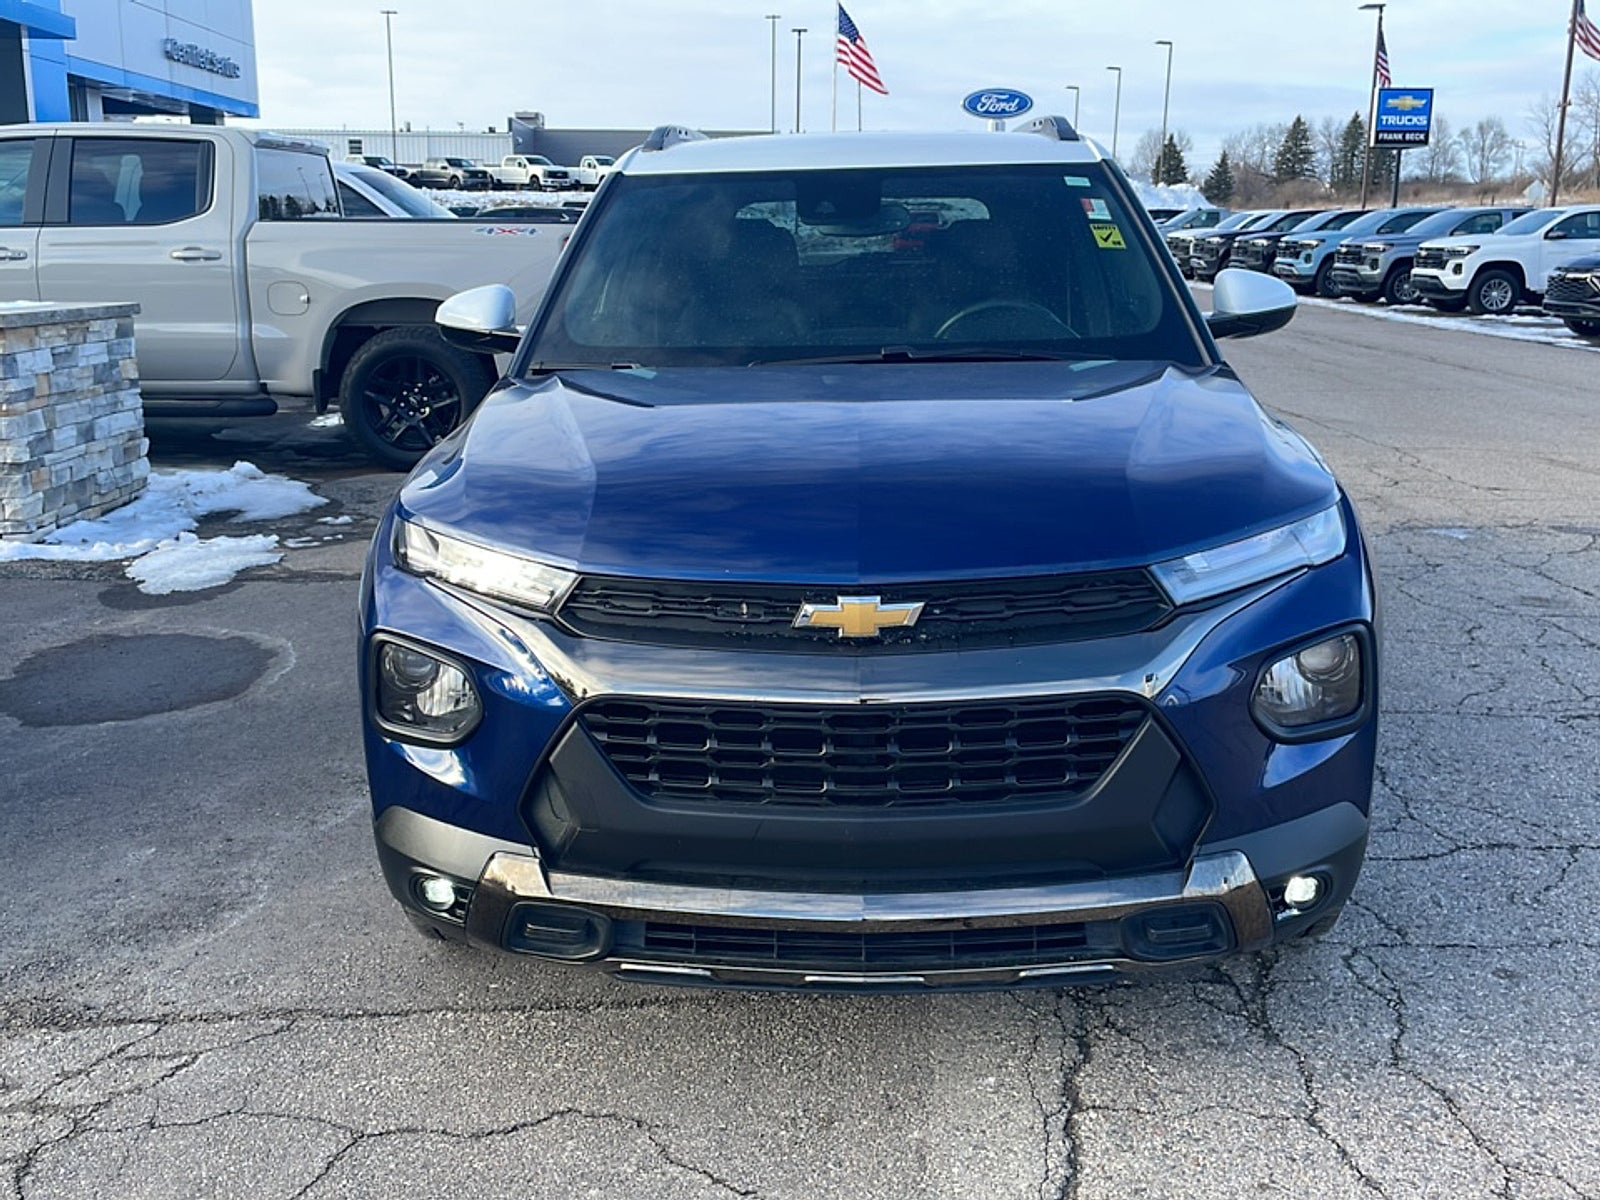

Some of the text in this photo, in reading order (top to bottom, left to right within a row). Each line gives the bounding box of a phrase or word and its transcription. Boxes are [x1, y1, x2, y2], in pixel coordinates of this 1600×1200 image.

[977, 94, 1019, 112] Ford
[1381, 115, 1427, 126] TRUCKS
[1378, 133, 1425, 141] FRANK BECK
